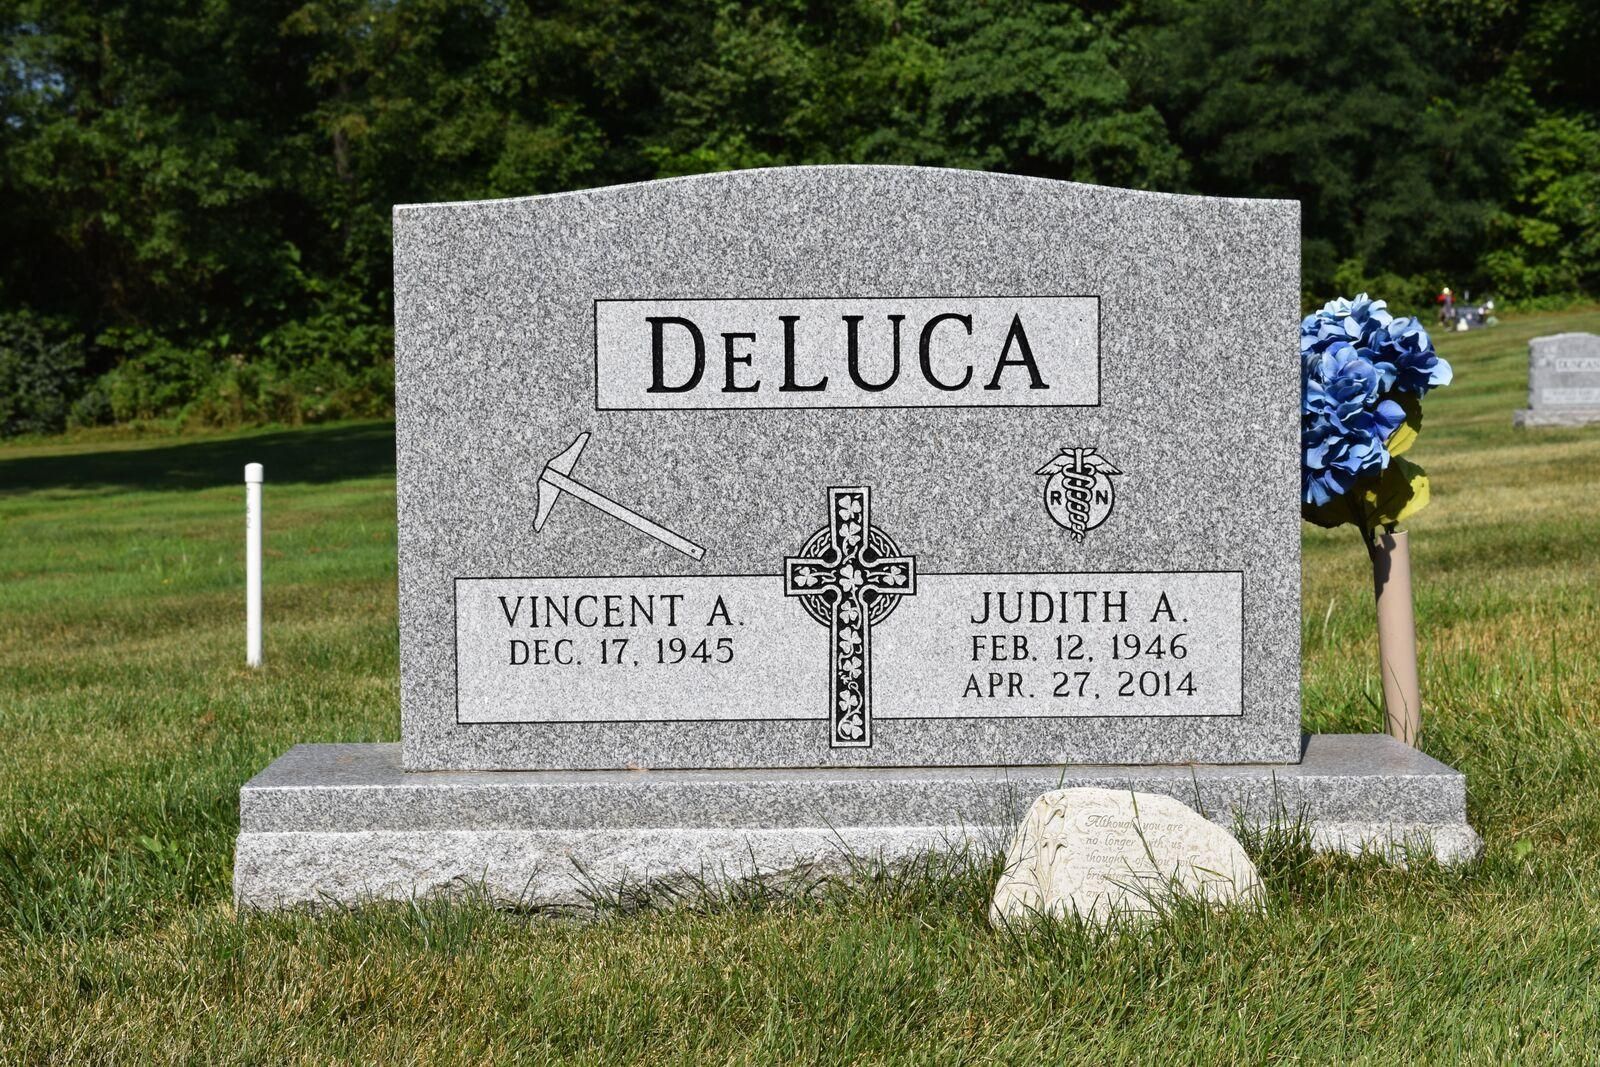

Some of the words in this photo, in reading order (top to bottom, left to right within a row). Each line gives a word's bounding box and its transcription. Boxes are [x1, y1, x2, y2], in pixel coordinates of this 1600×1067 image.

[1050, 490, 1062, 506] R
[1095, 490, 1109, 506] N
[498, 594, 684, 628] VINCENT
[706, 595, 745, 627] A.
[970, 590, 1128, 624] JUDITH
[1150, 591, 1188, 623] A.
[510, 638, 583, 665] DEC.
[600, 638, 640, 667] 17,
[656, 637, 735, 664] 1945
[971, 635, 1038, 662] FEB.
[1056, 634, 1094, 662] 12,
[1112, 633, 1188, 660] 1946
[962, 672, 1035, 698] APR.
[1053, 671, 1100, 699] 27,
[1118, 671, 1198, 697] 2014
[1086, 837, 1098, 845] no
[1104, 832, 1136, 850] longer
[1142, 822, 1161, 833] you
[1166, 823, 1184, 832] are
